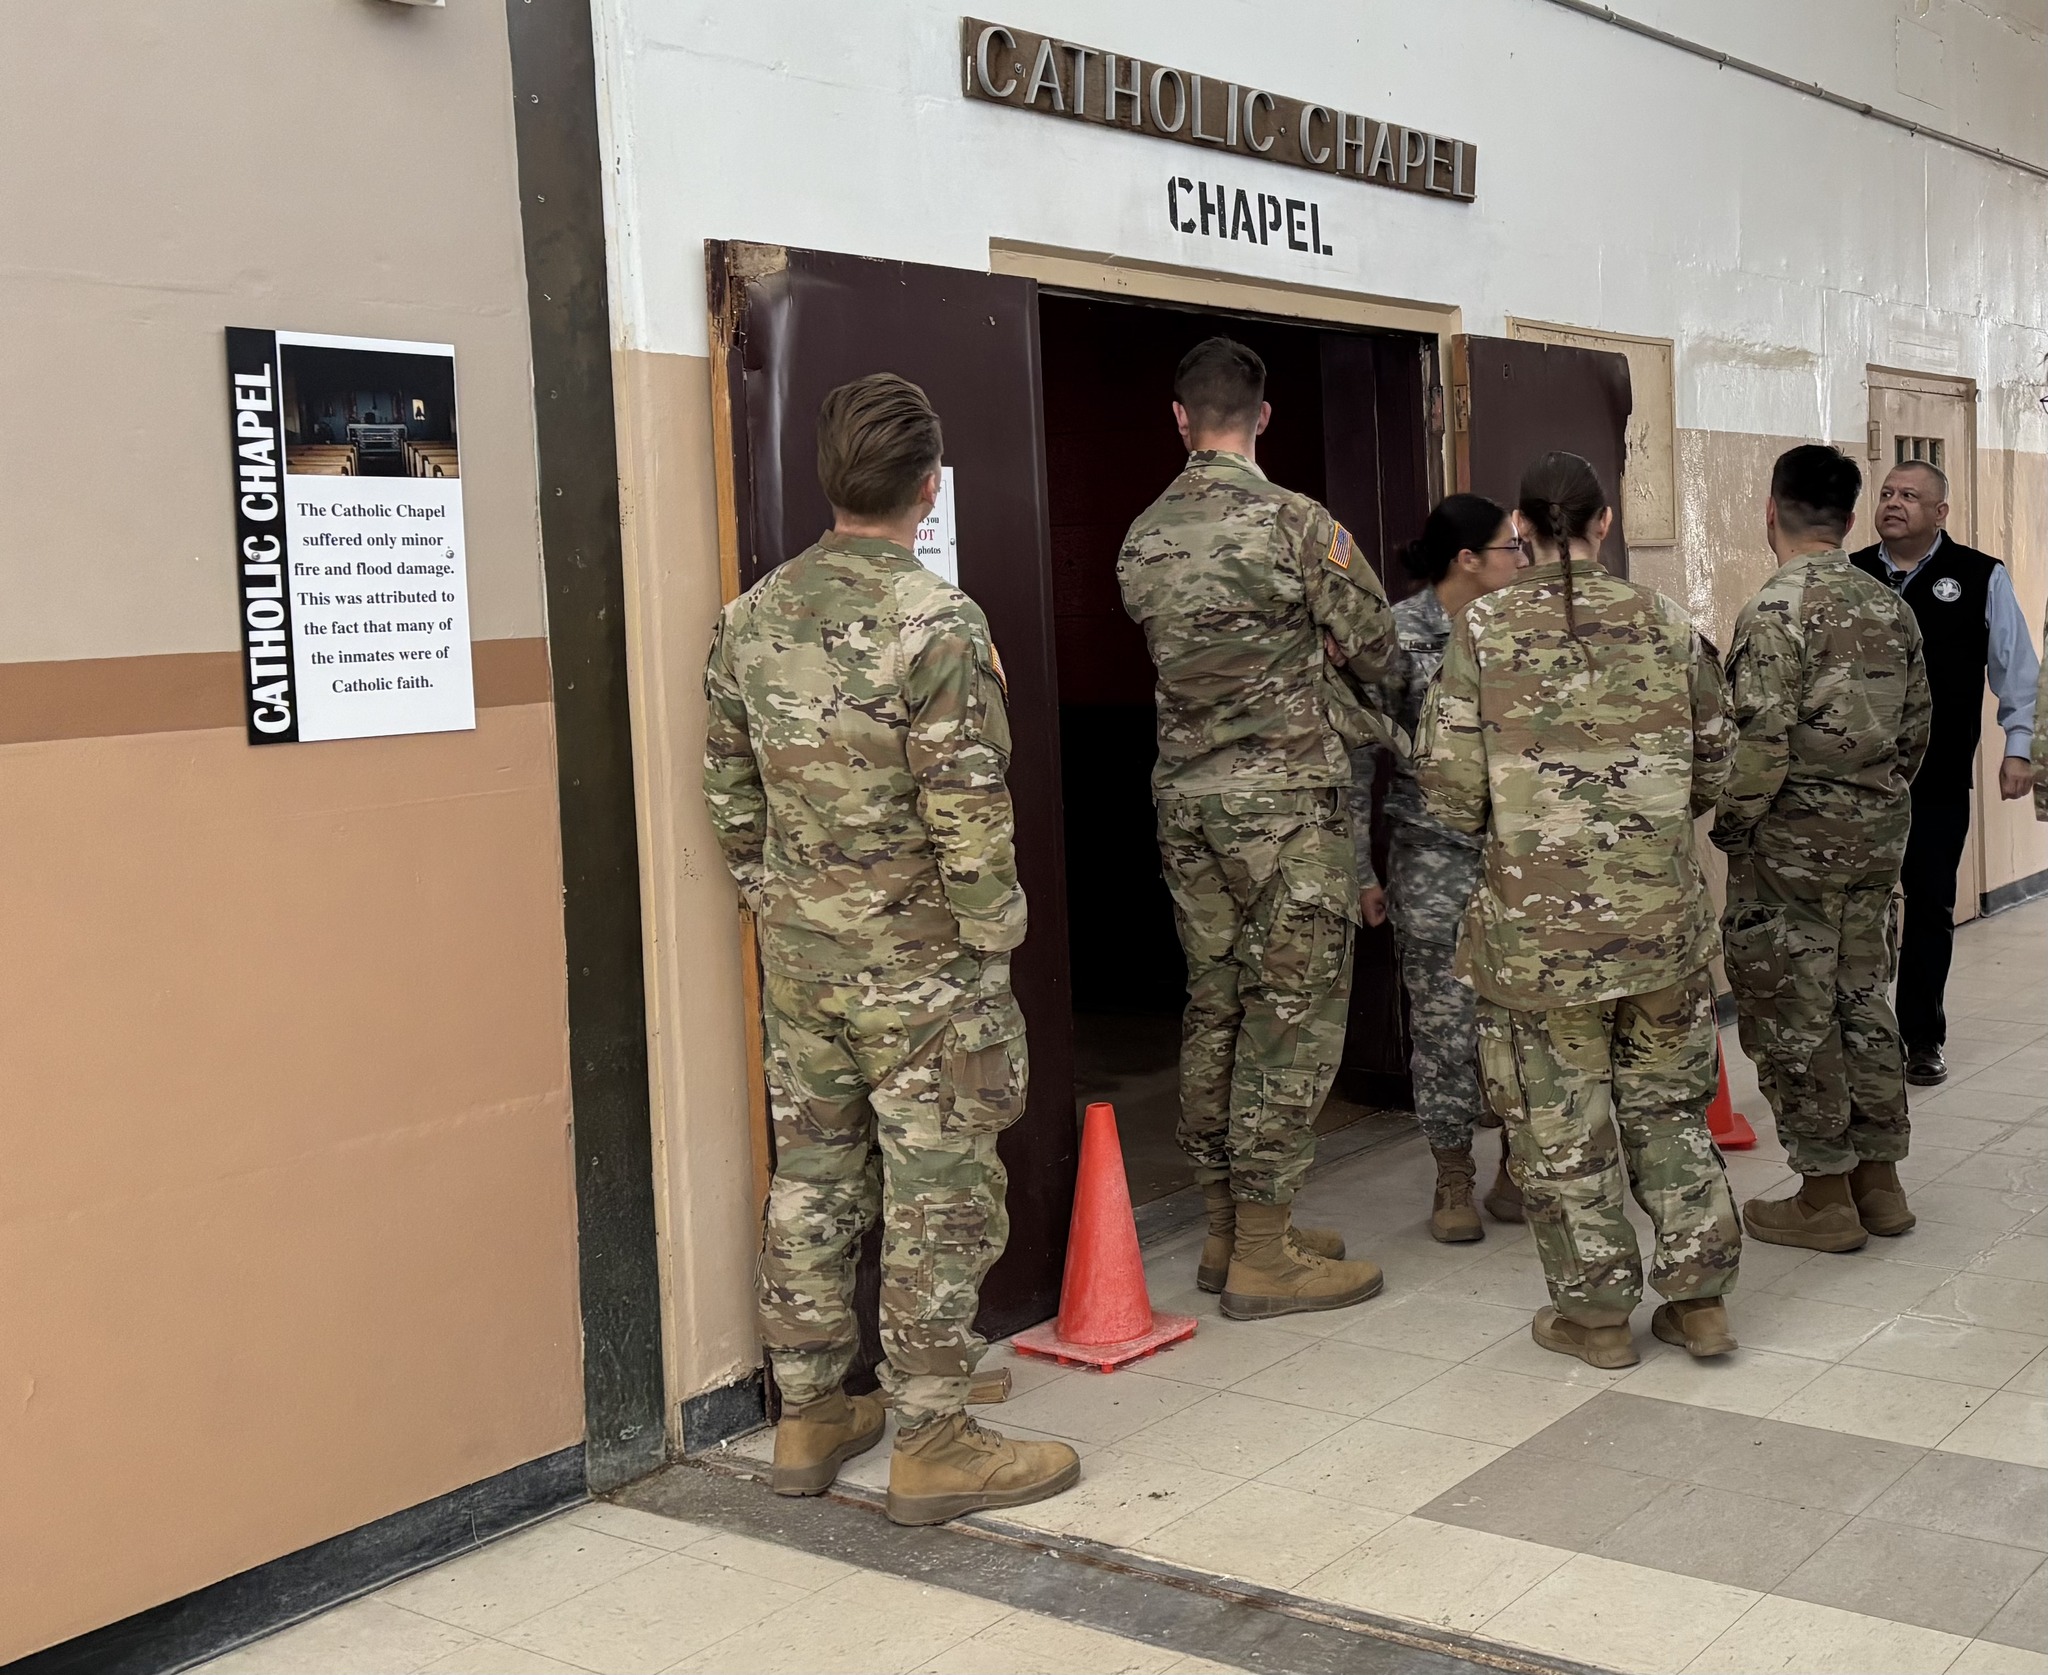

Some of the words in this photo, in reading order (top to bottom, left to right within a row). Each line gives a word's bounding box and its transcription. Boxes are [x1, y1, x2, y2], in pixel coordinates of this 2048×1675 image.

[976, 26, 1275, 152] CATHOLIC
[1301, 104, 1477, 199] CHAPEL
[1167, 176, 1333, 256] CHAPEL
[234, 363, 278, 521] CHAPEL
[296, 502, 327, 517] The
[331, 503, 392, 518] Catholic
[396, 504, 445, 521] Chapel
[926, 517, 940, 526] you
[302, 532, 363, 546] suffered
[366, 533, 397, 550] only
[401, 532, 444, 546] minor
[915, 528, 935, 541] OT
[917, 545, 942, 557] photos
[294, 562, 320, 576] fire
[324, 562, 352, 576] and
[356, 561, 393, 575] flood
[396, 561, 455, 578] damage.
[296, 591, 331, 606] This
[334, 594, 363, 605] was
[366, 589, 437, 604] attributed
[441, 591, 455, 603] to
[243, 534, 291, 734] CATHOLIC
[304, 621, 328, 636] the
[331, 621, 359, 635] fact
[363, 620, 392, 634] that
[396, 621, 435, 635] many
[438, 617, 453, 631] of
[311, 651, 334, 665] the
[338, 650, 395, 664] inmates
[398, 650, 432, 660] were
[435, 645, 450, 659] of
[332, 677, 393, 693] Catholic
[397, 675, 434, 690] faith.
